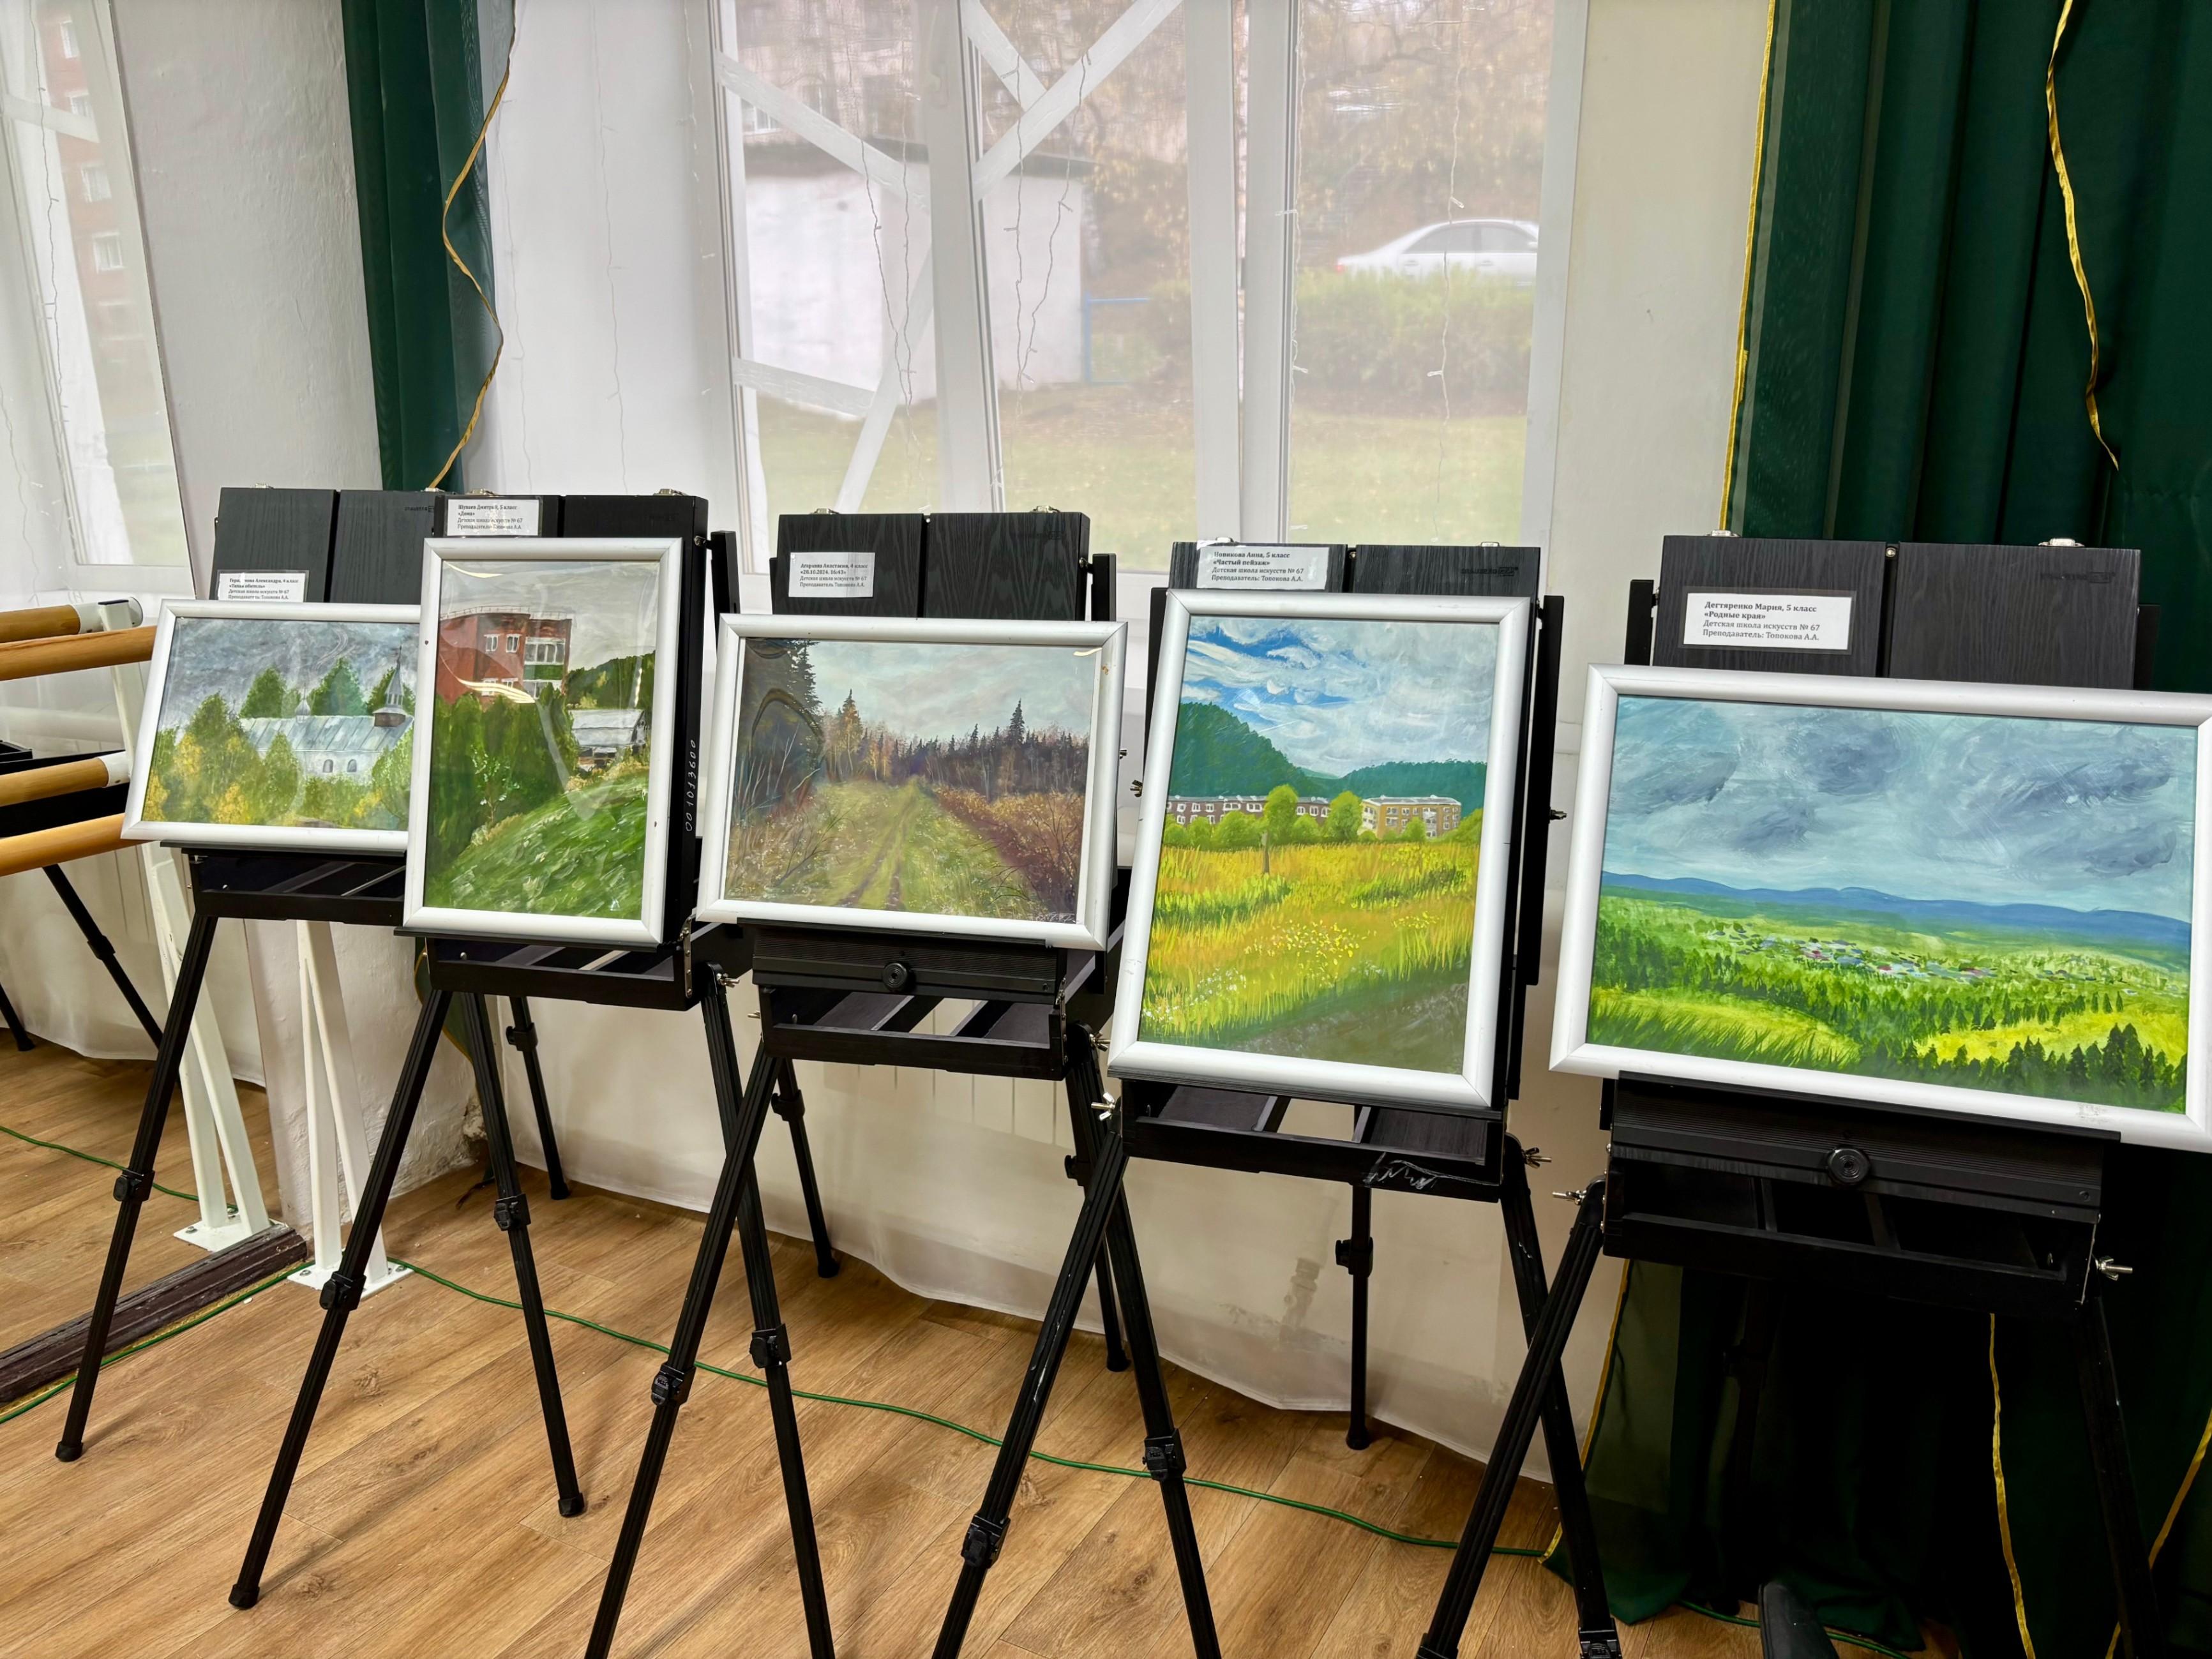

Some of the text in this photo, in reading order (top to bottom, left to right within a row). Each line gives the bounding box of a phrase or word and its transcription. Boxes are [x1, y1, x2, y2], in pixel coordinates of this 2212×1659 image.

[1704, 601, 1753, 610] Дегтяренко
[1755, 603, 1784, 612] Мария,
[1703, 629, 1764, 638] Преподаватель:
[1765, 632, 1802, 640] Топокова
